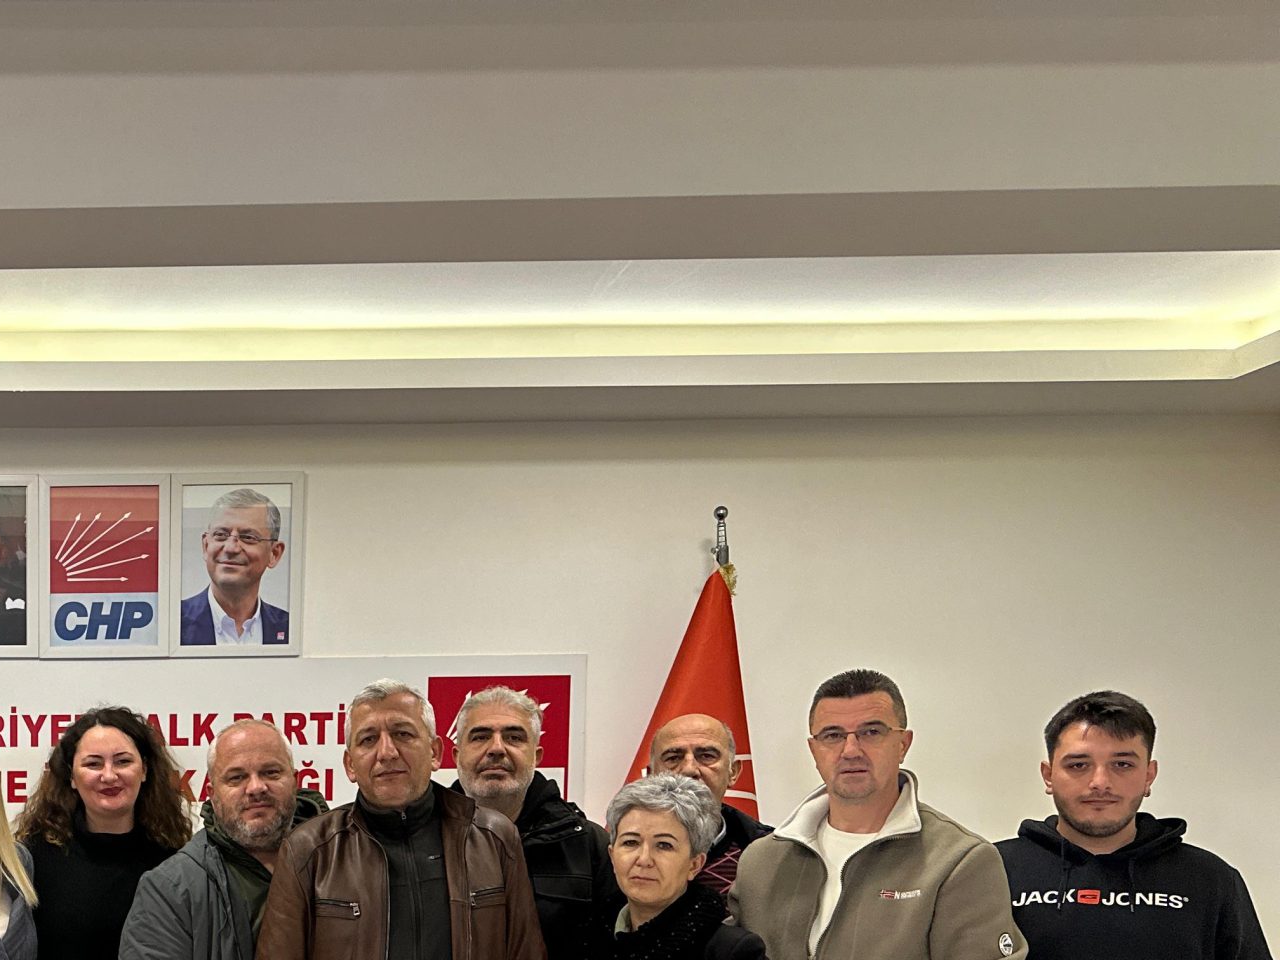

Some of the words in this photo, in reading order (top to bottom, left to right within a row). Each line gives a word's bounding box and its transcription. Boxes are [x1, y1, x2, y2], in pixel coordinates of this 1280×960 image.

[54, 601, 154, 642] CHP
[146, 713, 219, 747] ALK
[1012, 888, 1076, 907] JACK
